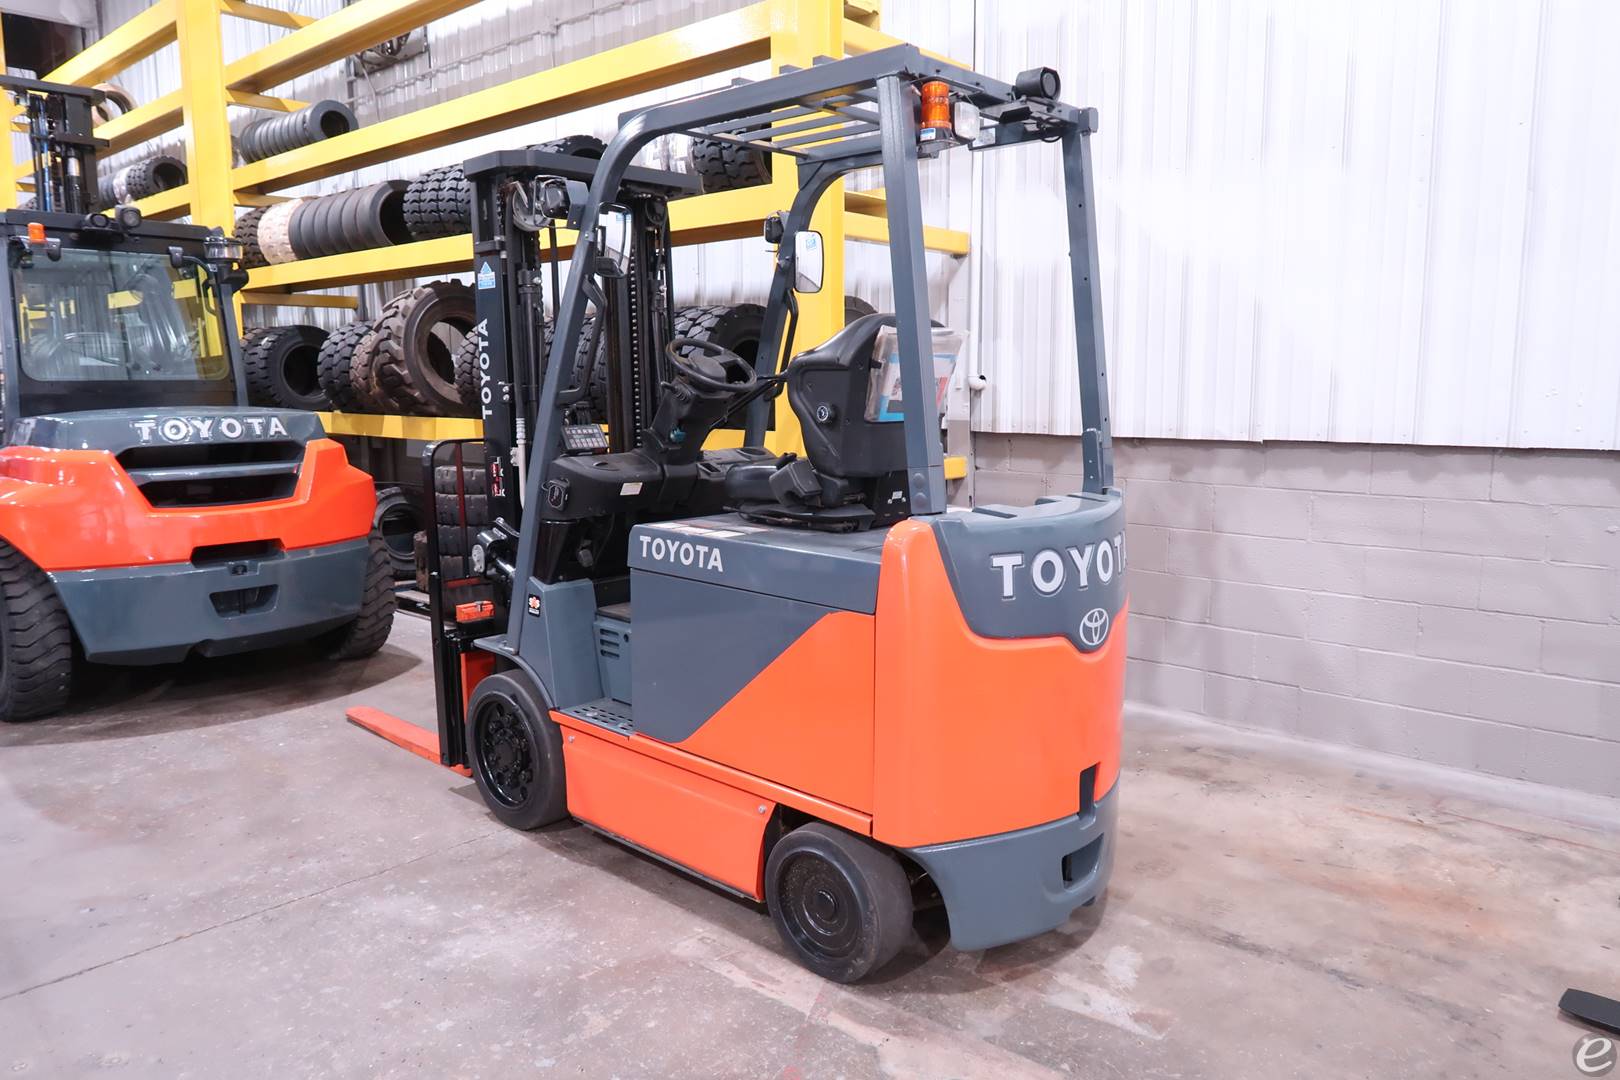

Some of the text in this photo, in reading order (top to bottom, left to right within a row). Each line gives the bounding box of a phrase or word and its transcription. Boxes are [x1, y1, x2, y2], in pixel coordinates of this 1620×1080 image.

[477, 318, 493, 420] TOYOTA
[134, 416, 289, 442] TOYOTA
[639, 535, 724, 573] TOYOTA
